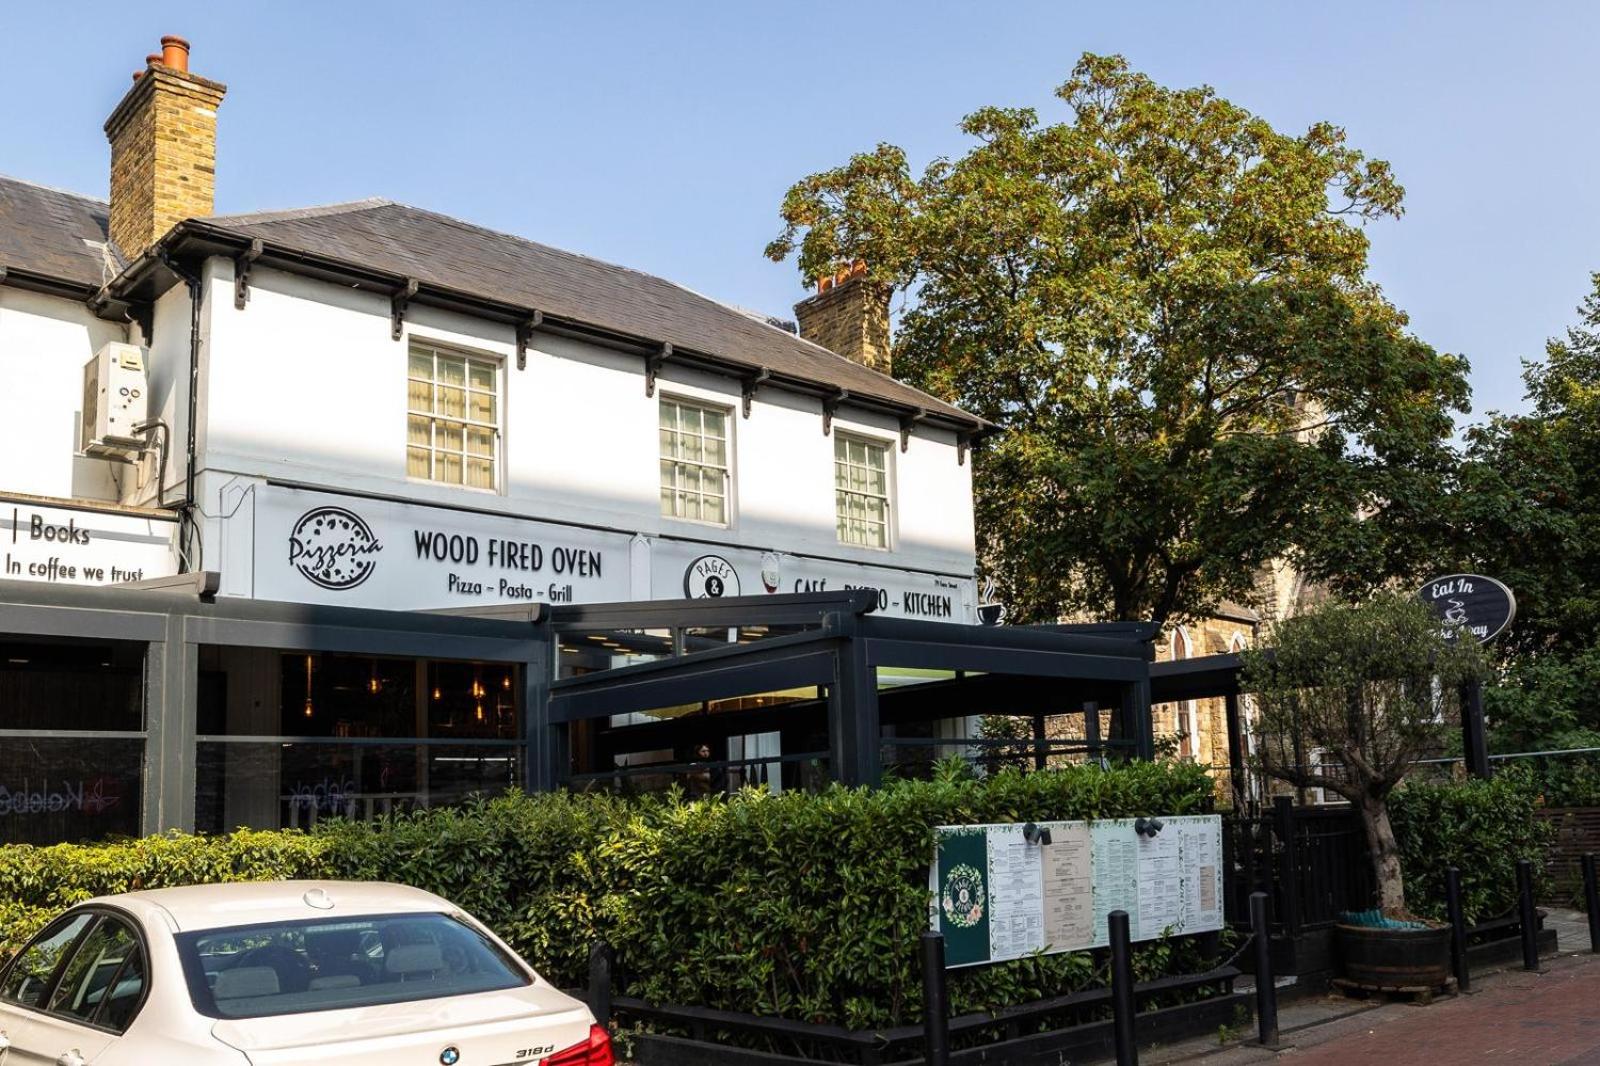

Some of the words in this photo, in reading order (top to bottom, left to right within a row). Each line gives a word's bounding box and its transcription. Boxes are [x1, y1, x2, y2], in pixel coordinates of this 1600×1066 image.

[30, 514, 90, 545] Books
[288, 537, 384, 568] Pizzeria
[414, 530, 479, 565] WOOD
[488, 539, 543, 572] FIRED
[552, 547, 602, 577] OVEN
[6, 553, 21, 574] In
[28, 556, 77, 581] coffee
[83, 566, 104, 580] we
[111, 566, 143, 582] trust
[696, 560, 732, 579] PAGES
[448, 573, 482, 595] Pizza
[499, 578, 532, 600] Pasta
[548, 583, 572, 602] Grill
[1432, 581, 1455, 598] Eat
[1457, 578, 1474, 593] In
[903, 592, 952, 617] KITCHEN
[516, 1045, 554, 1058] 318d
